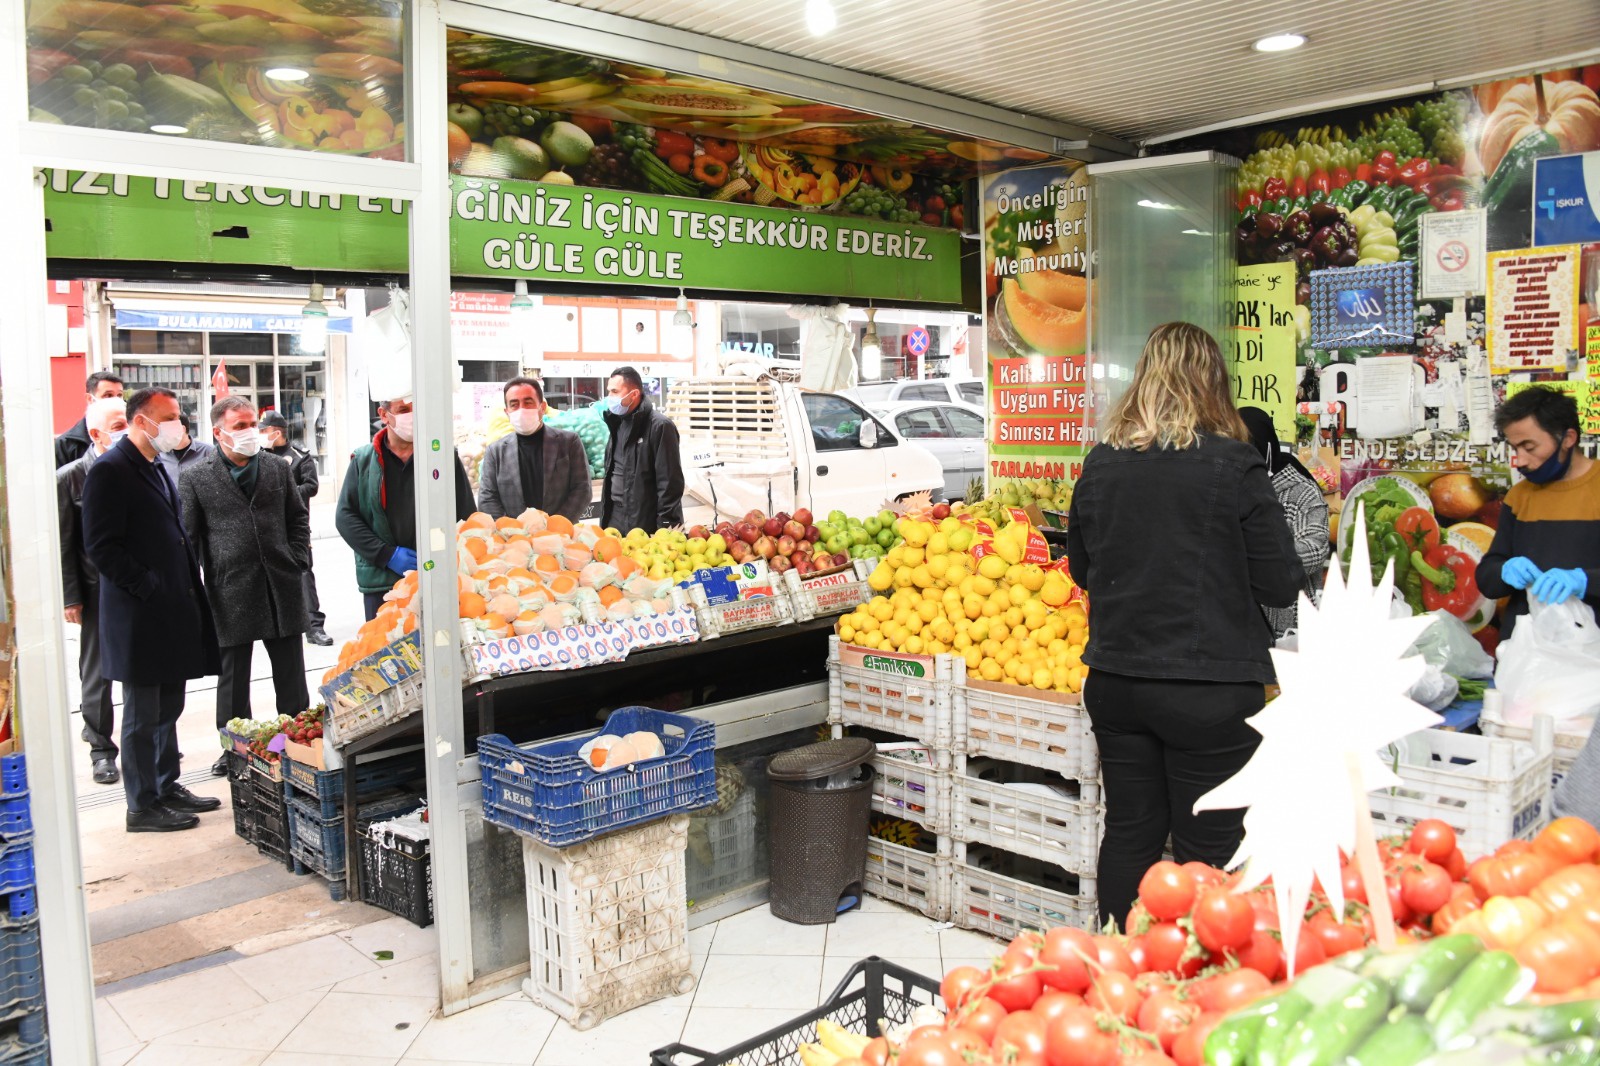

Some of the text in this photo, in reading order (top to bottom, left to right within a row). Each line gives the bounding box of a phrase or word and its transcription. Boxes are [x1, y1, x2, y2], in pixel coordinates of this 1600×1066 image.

[581, 193, 659, 239] İÇİN
[667, 210, 828, 251] TEŞEKKÜR
[836, 228, 933, 261] EDERİZ.
[482, 232, 584, 274] GÜLE
[594, 241, 684, 280] GÜLE
[157, 315, 253, 329] BULAMADIM
[720, 341, 775, 359] NAZAR
[999, 389, 1048, 413] Uygun
[999, 421, 1055, 442] Sınırsız
